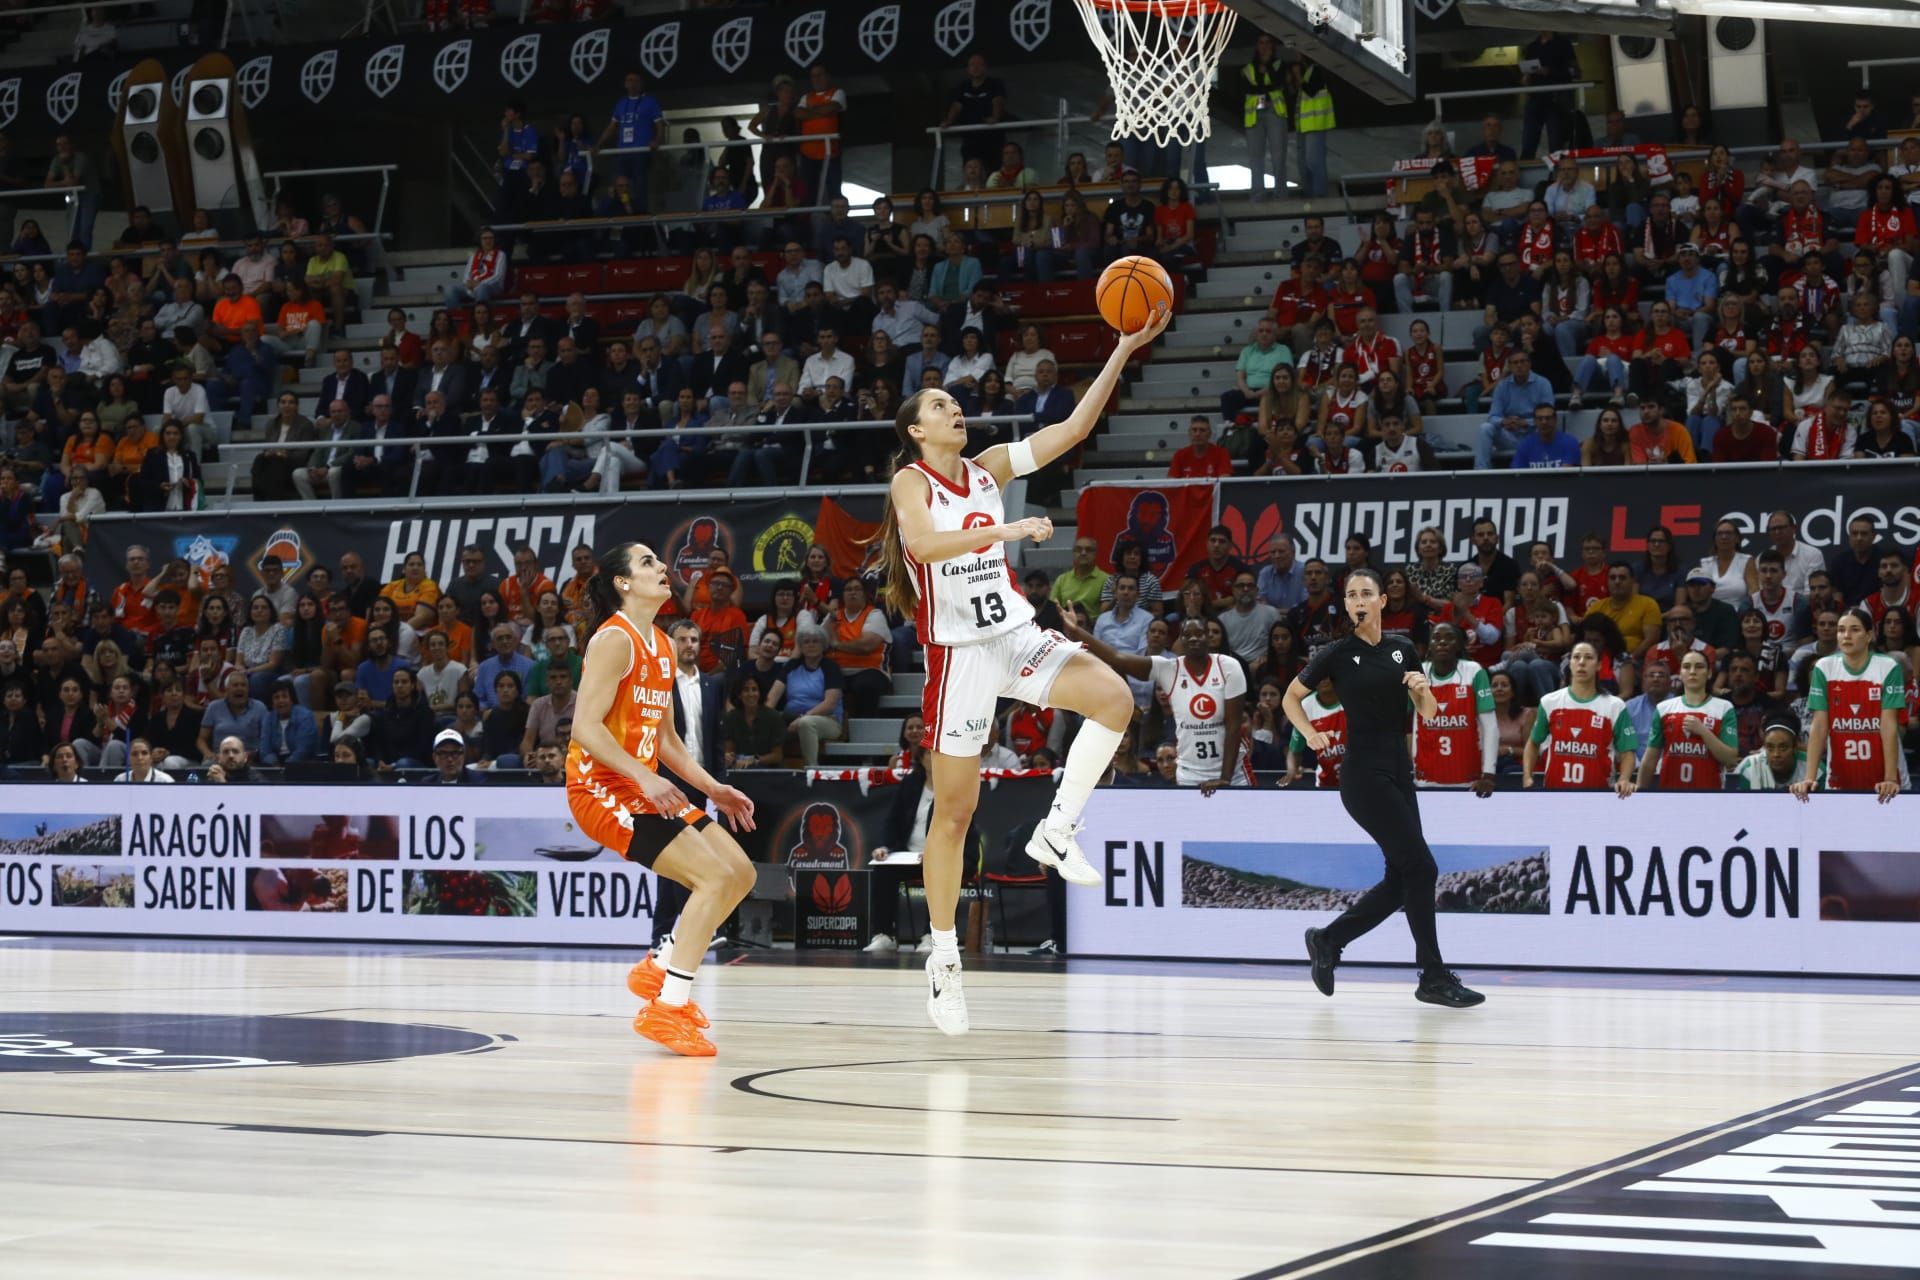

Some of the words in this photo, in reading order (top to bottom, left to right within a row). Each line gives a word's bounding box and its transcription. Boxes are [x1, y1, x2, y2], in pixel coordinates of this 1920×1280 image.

[1292, 497, 1569, 564] SUPERCOPA
[380, 514, 596, 595] HUESCA
[967, 570, 1001, 584] ZARAGOZA
[970, 591, 1007, 628] 13
[1833, 717, 1880, 730] AMBAR
[1195, 741, 1219, 760] 31
[1439, 736, 1452, 756] 3
[1844, 739, 1872, 761] 20
[1562, 762, 1584, 784] 10
[1680, 762, 1693, 783] 0
[127, 803, 252, 858] ARAGÓN
[409, 815, 465, 860] LOS
[791, 858, 845, 869] Casademont
[1105, 841, 1164, 907] EN
[1564, 828, 1800, 918] ARAGÓN
[143, 865, 236, 911] SABEN
[357, 868, 395, 914] DE
[807, 916, 858, 930] SUPERCOPA
